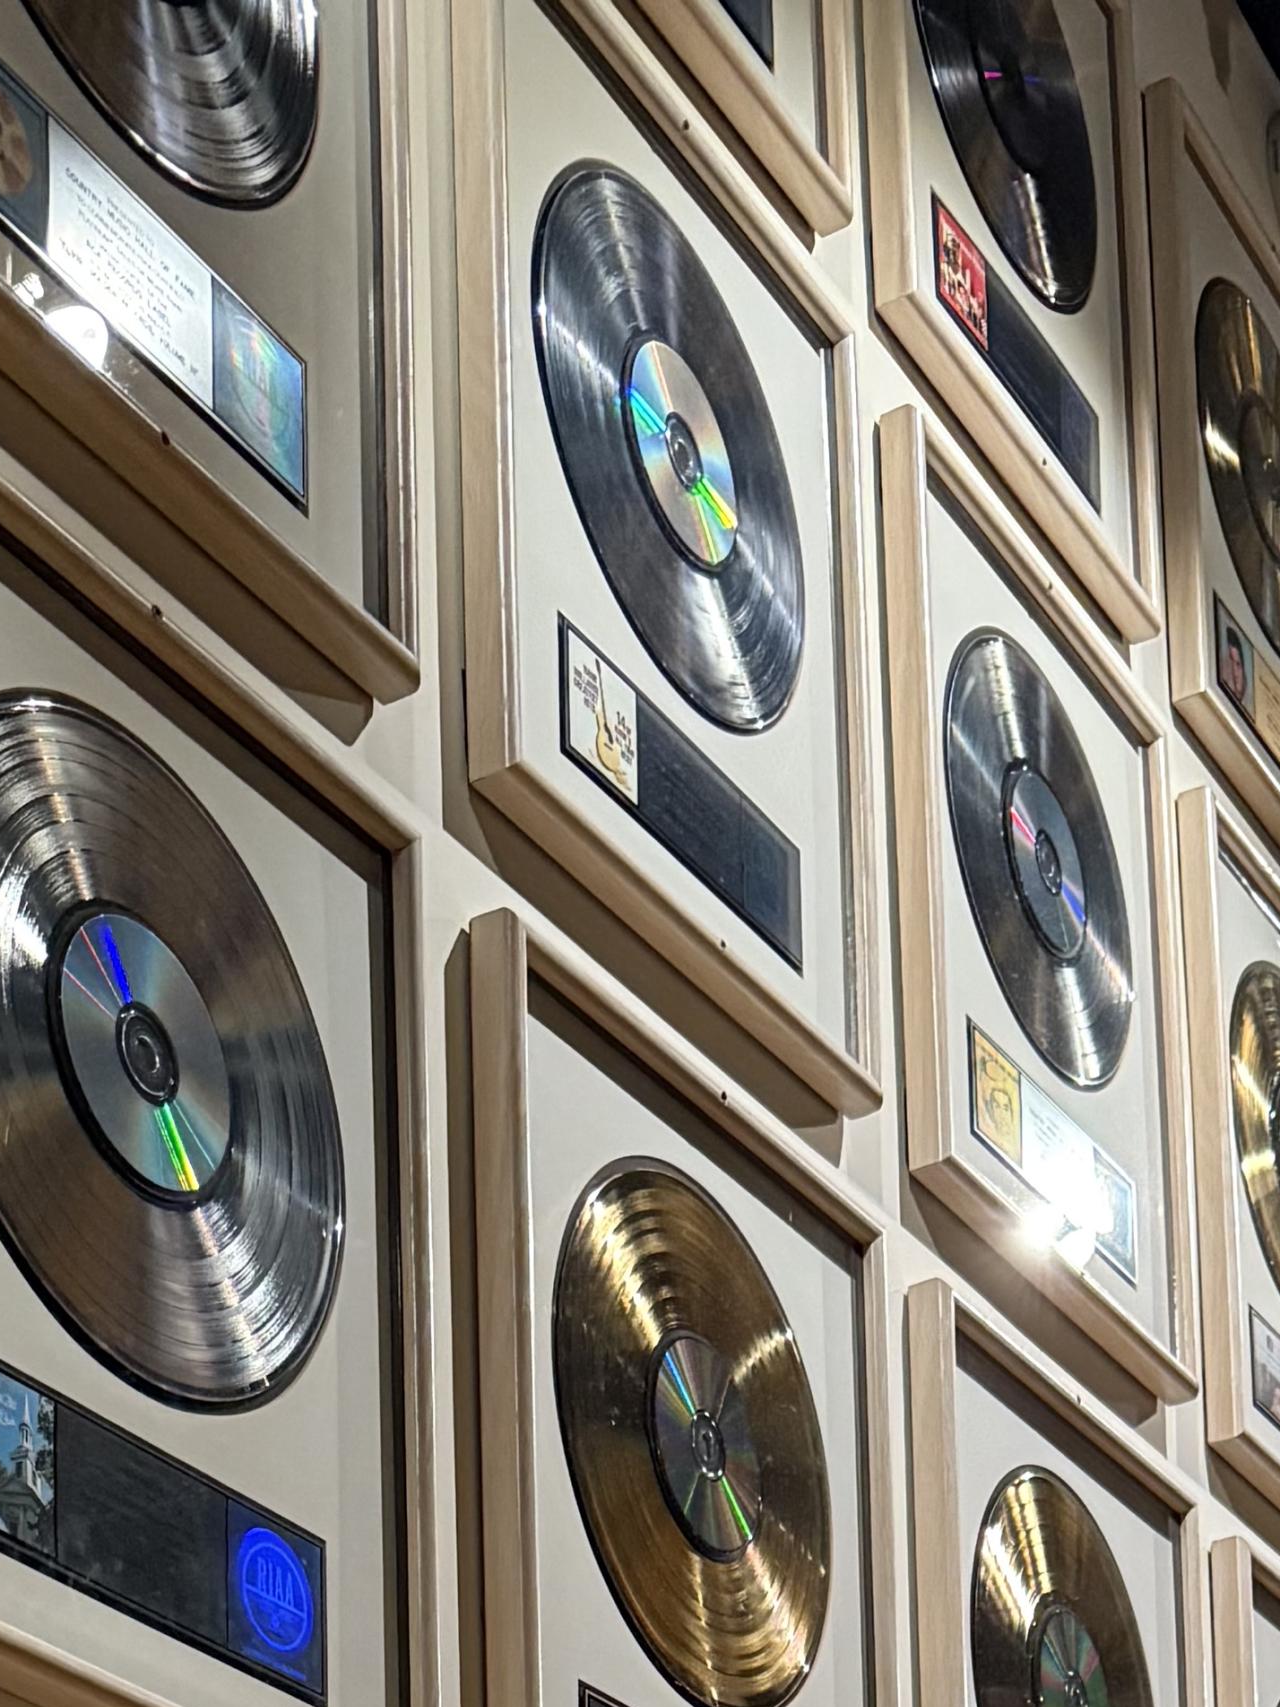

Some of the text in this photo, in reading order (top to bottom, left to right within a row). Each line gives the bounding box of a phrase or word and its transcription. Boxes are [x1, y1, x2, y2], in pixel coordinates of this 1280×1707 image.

[65, 167, 101, 206] COUNTRY
[106, 208, 130, 236] MUSIC
[257, 1556, 295, 1609] RIAA
